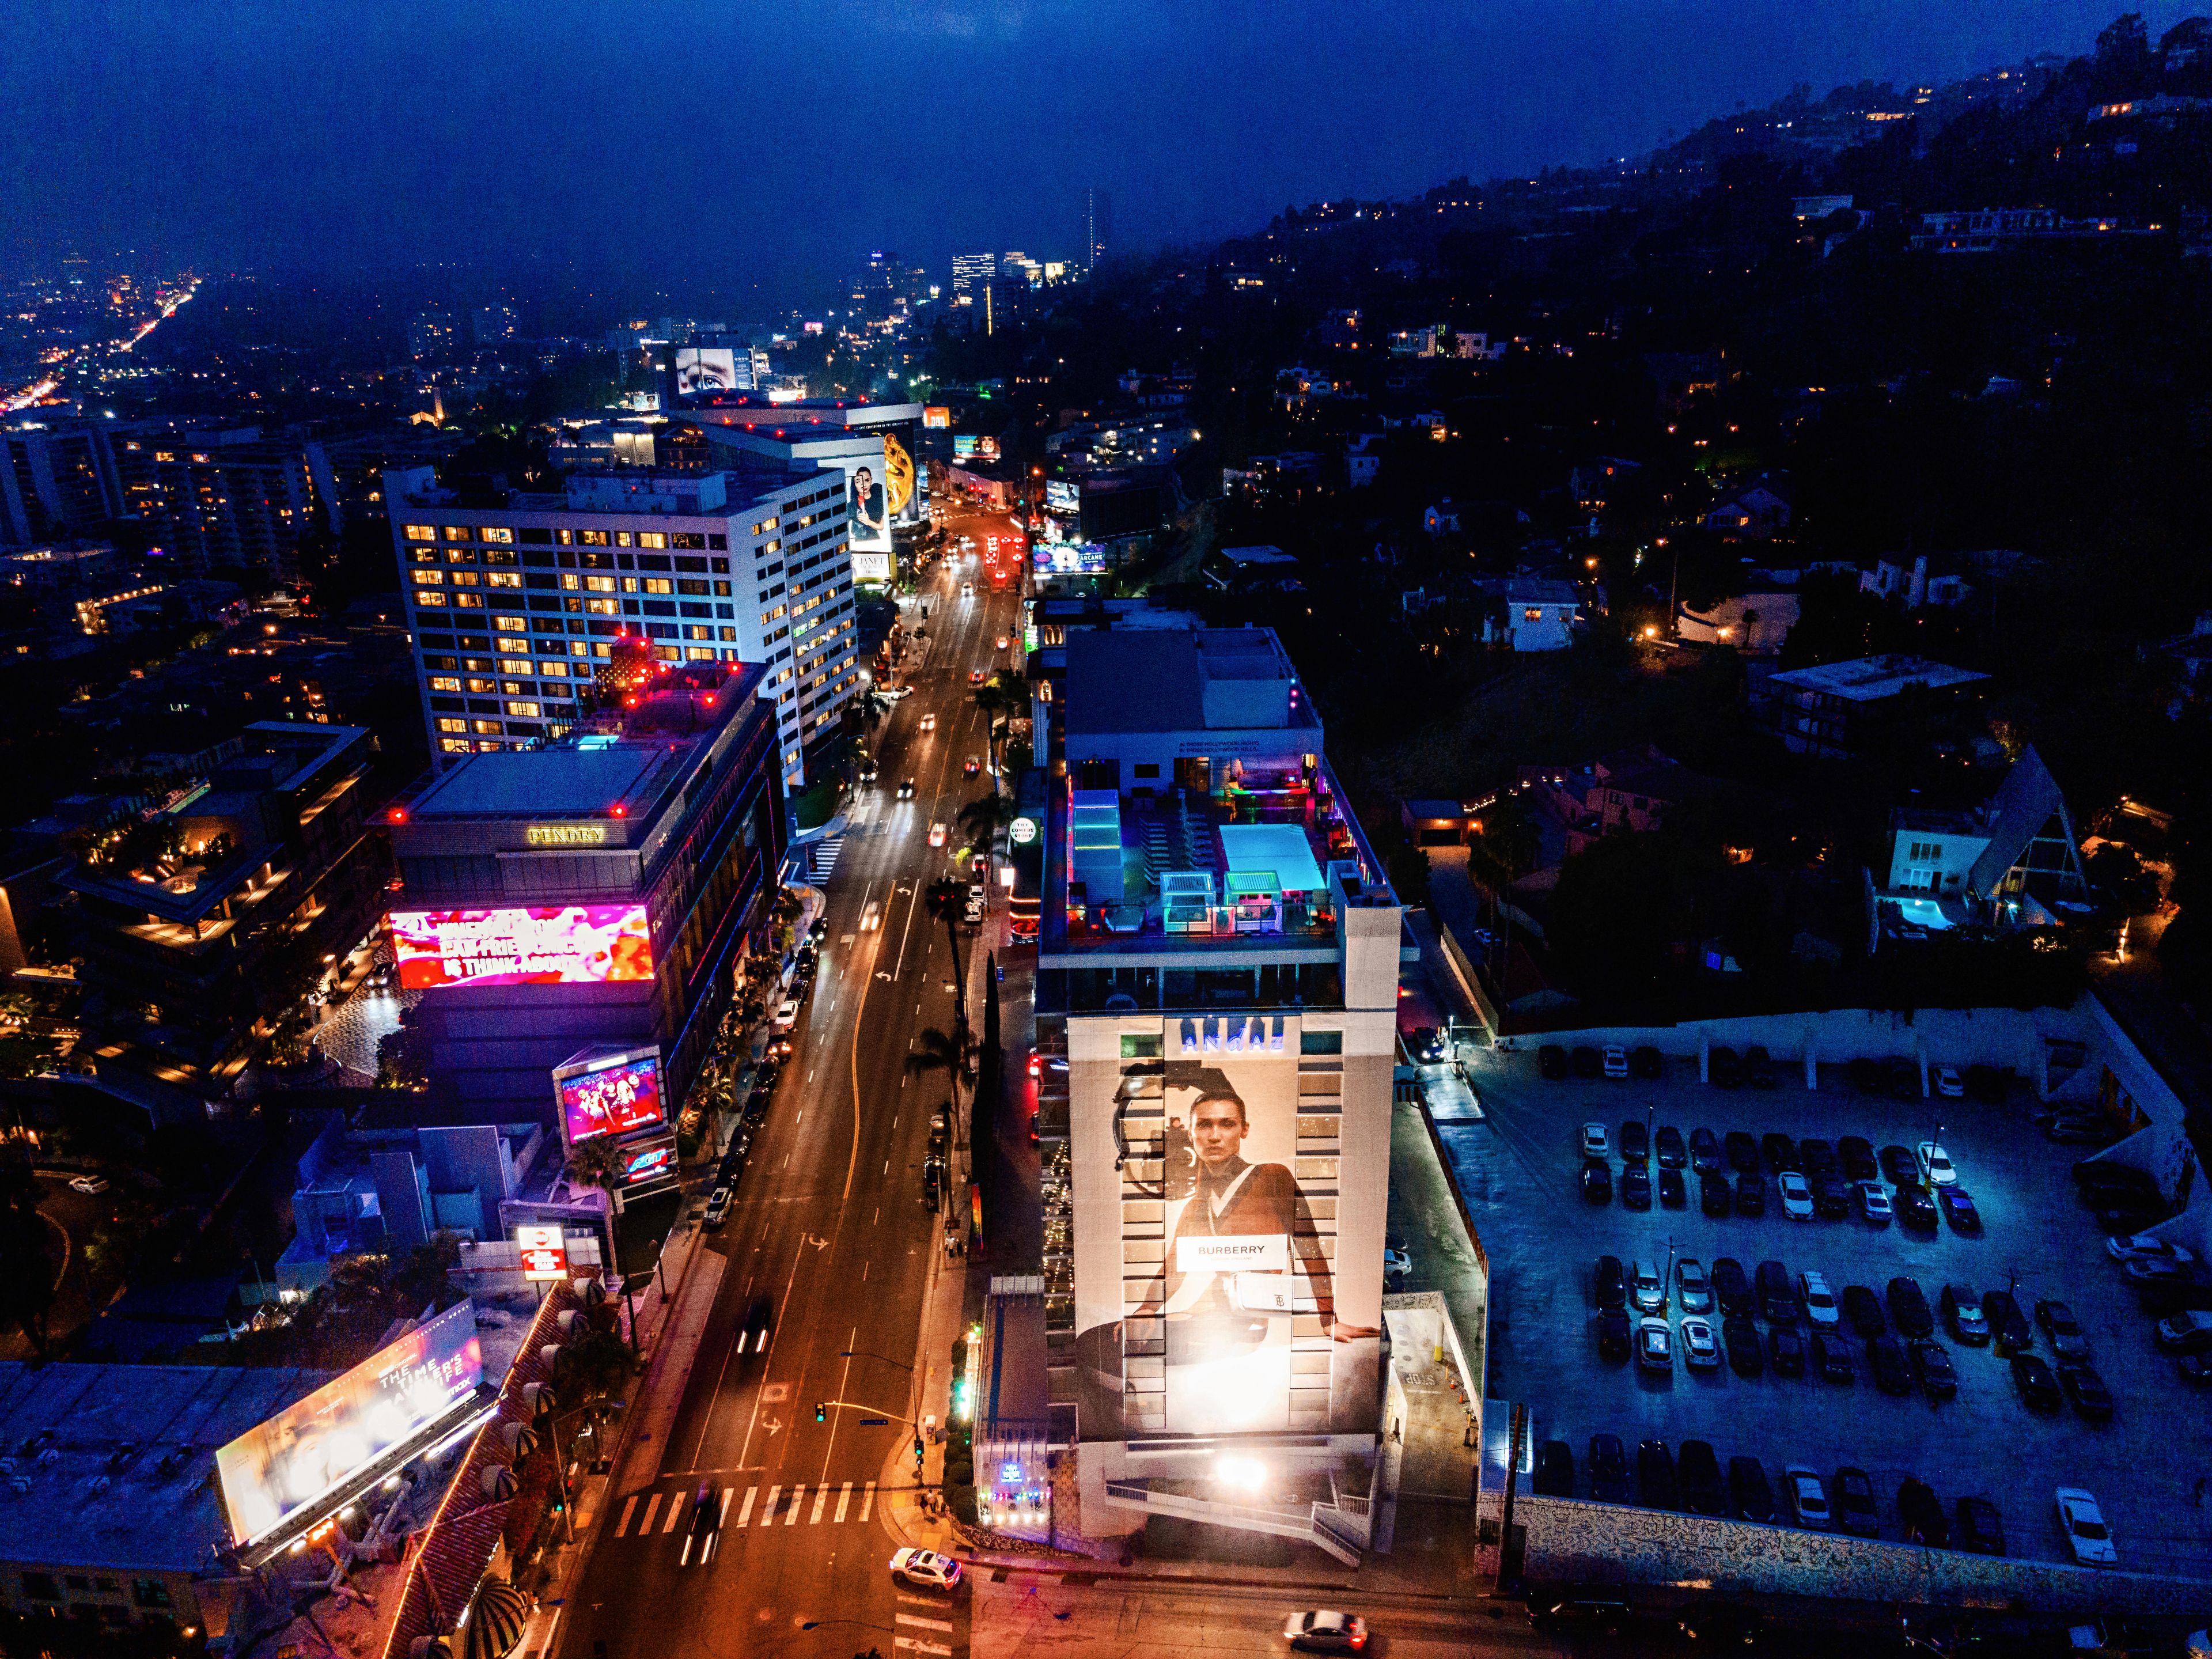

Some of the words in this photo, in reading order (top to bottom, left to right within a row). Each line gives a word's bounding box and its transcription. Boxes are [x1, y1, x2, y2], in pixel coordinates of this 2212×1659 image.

[529, 827, 604, 843] PENDRY
[443, 959, 463, 976] IS
[462, 956, 518, 975] THINK
[1199, 1245, 1265, 1255] BURBERRY
[395, 1353, 418, 1369] ORIGINAL
[380, 1364, 411, 1389] THE
[397, 1358, 437, 1389] TIME
[1406, 1373, 1435, 1385] STOP
